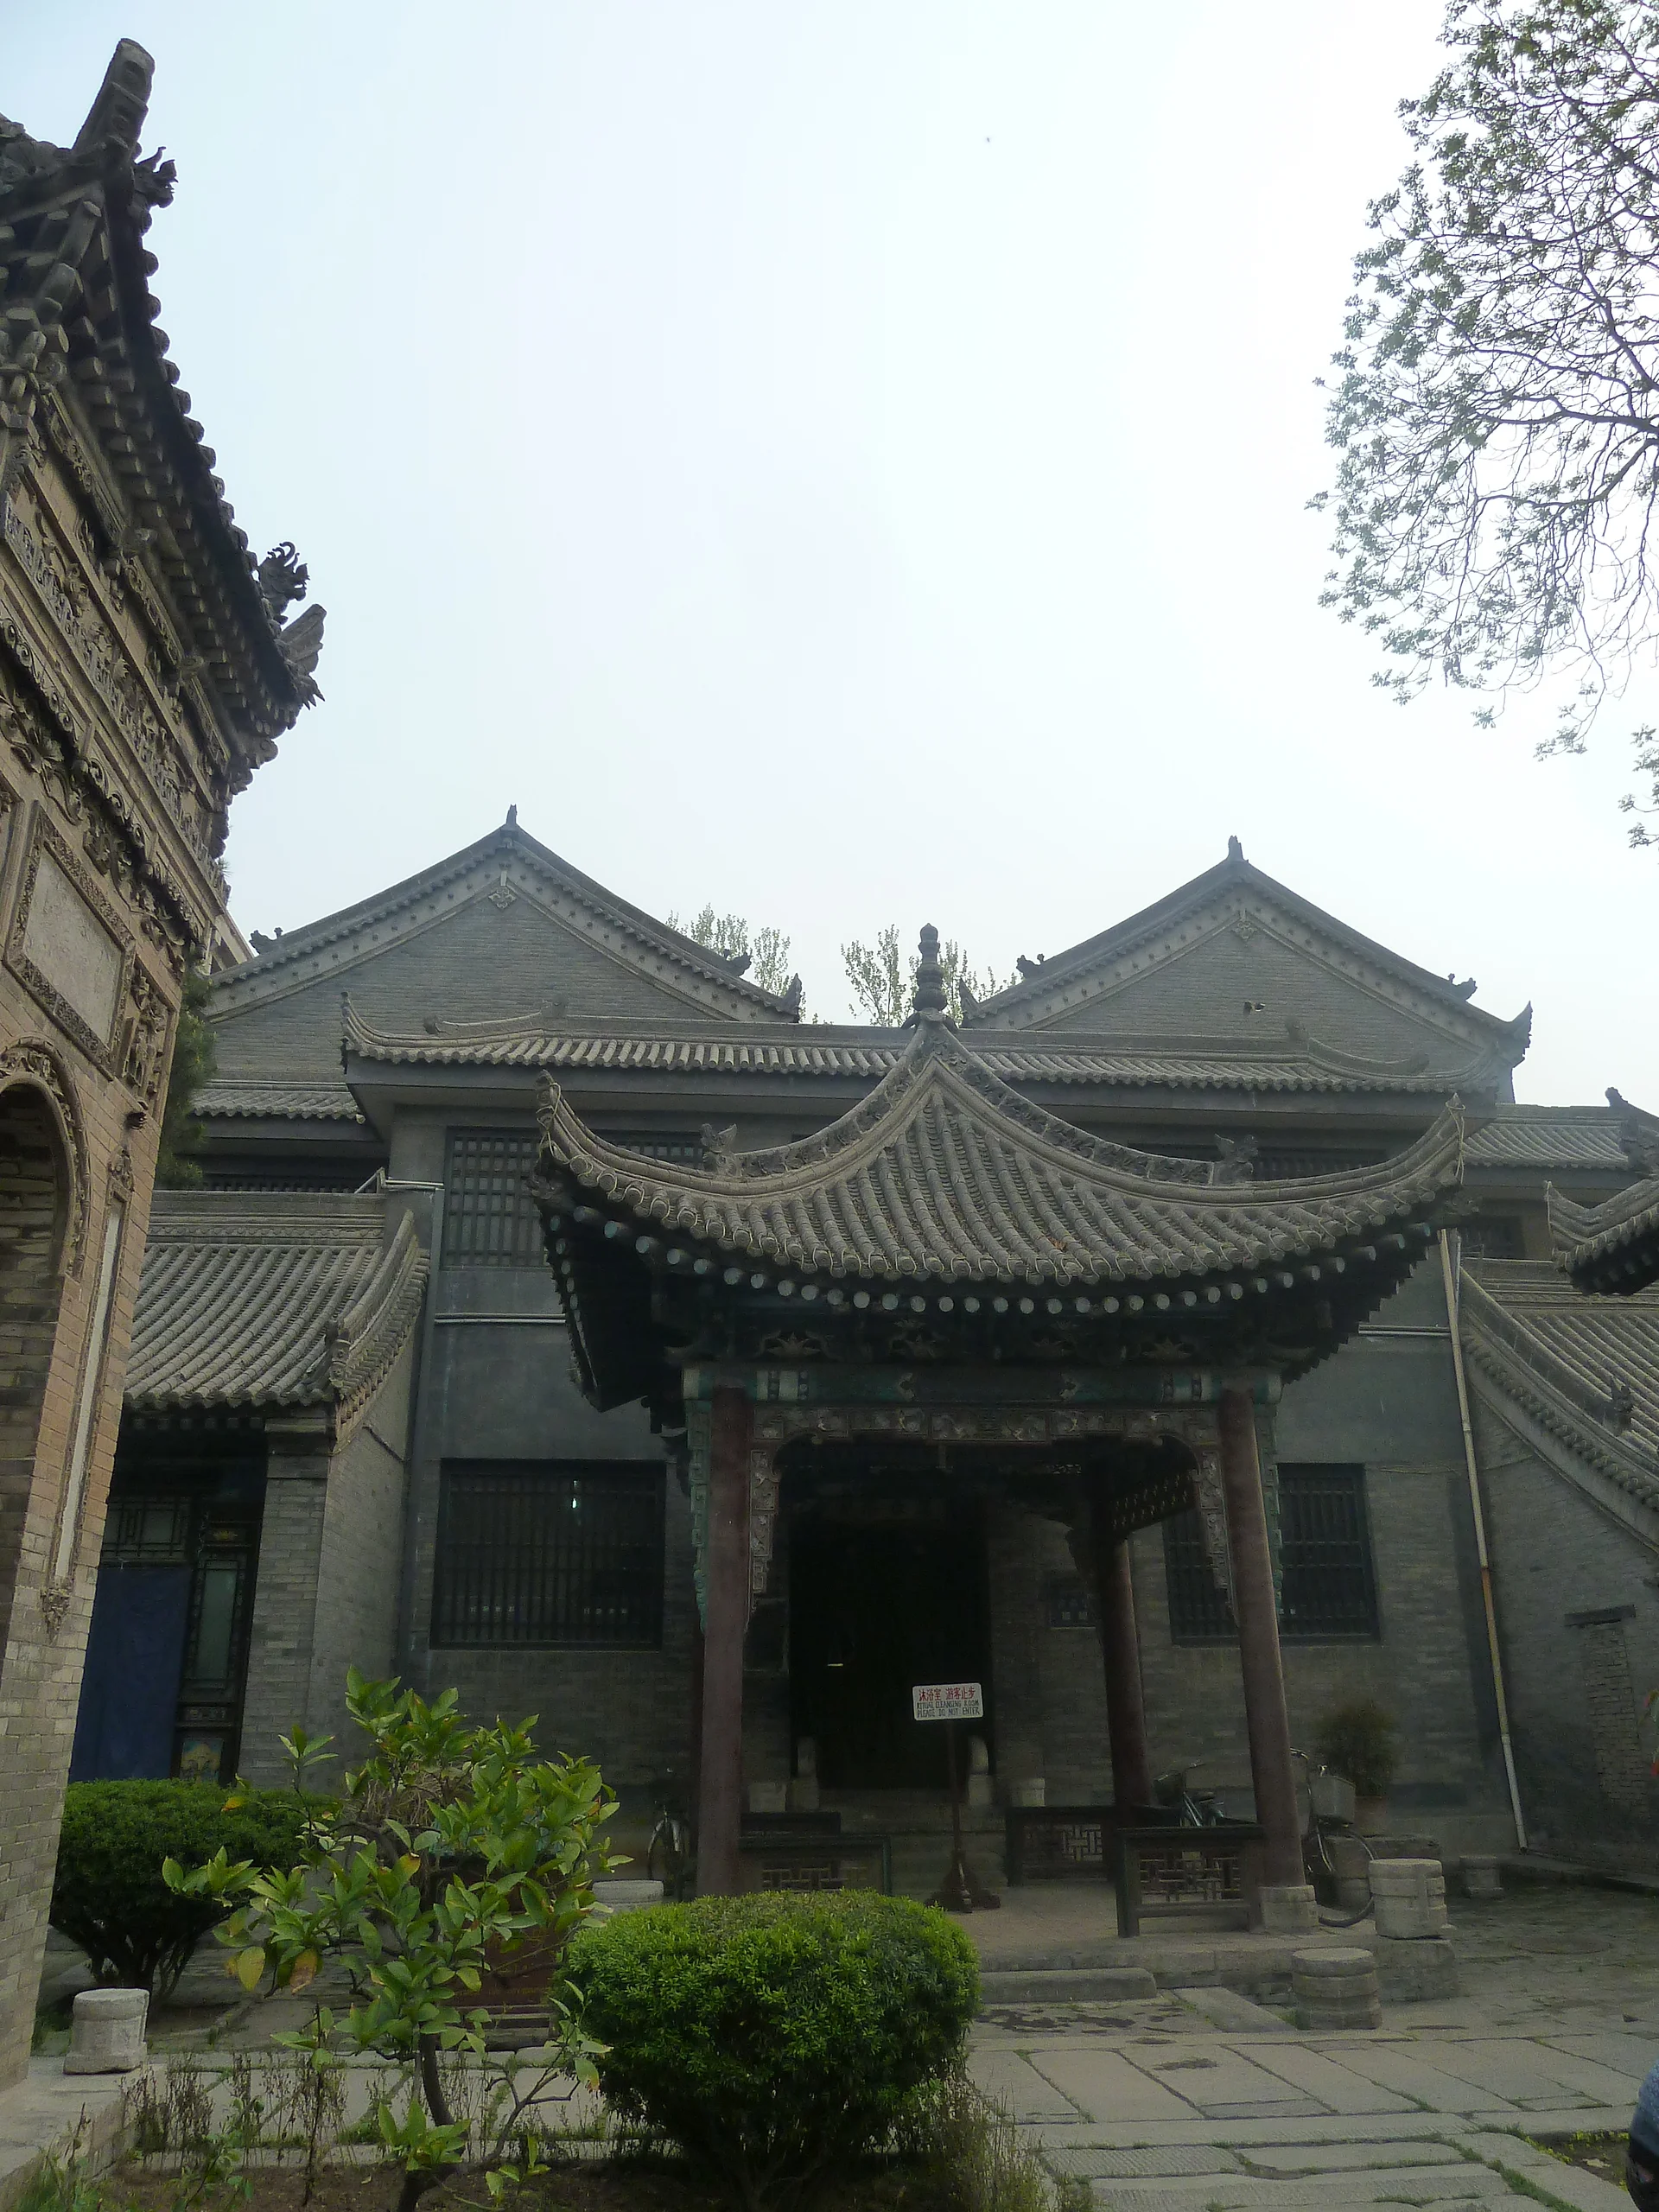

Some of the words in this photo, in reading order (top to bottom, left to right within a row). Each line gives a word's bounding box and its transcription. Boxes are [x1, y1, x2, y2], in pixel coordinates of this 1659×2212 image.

[918, 1688, 942, 1701] 沐浴室
[945, 1686, 976, 1700] 游客止步
[918, 1709, 935, 1718] PLEASE
